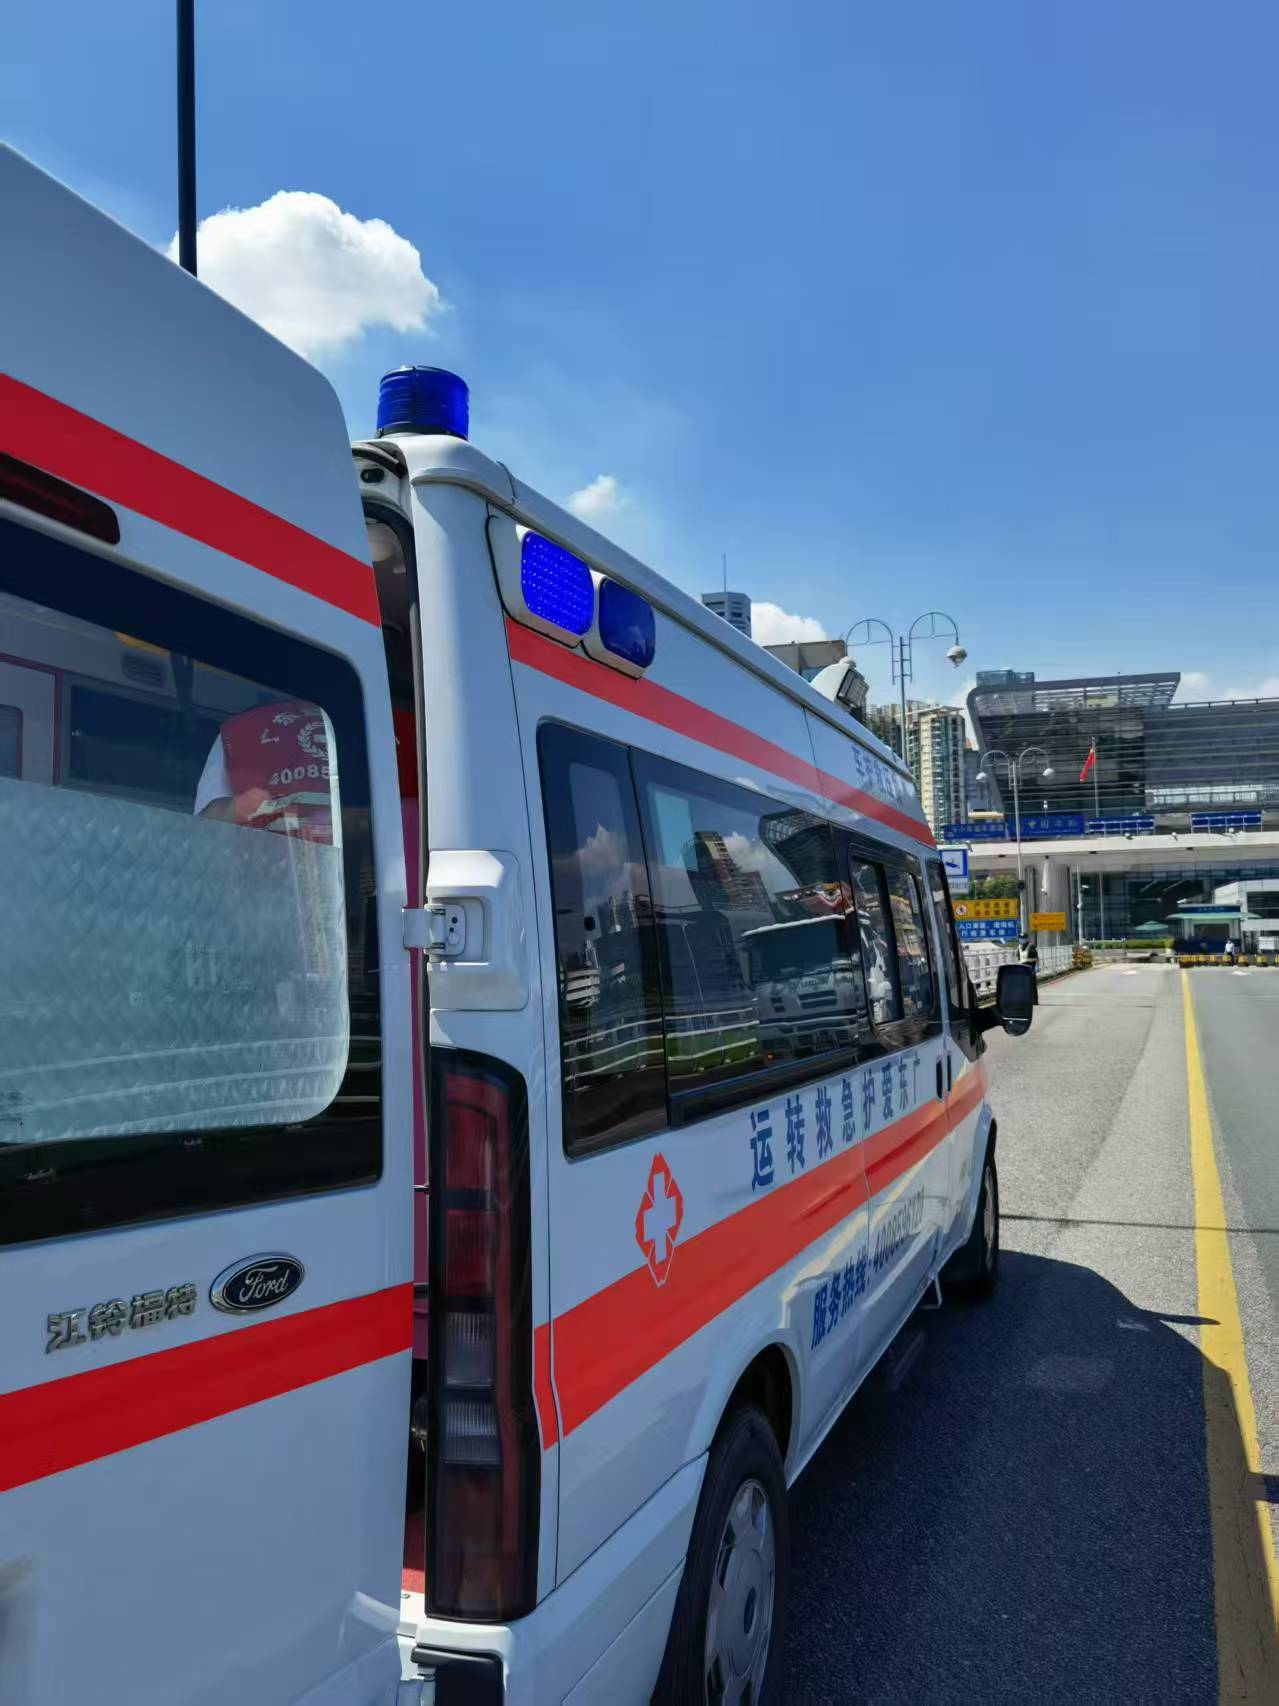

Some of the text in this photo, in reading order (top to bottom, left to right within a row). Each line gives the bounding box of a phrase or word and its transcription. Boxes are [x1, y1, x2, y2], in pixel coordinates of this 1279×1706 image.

[238, 1264, 291, 1303] Ford
[46, 1282, 197, 1355] 江铃福特
